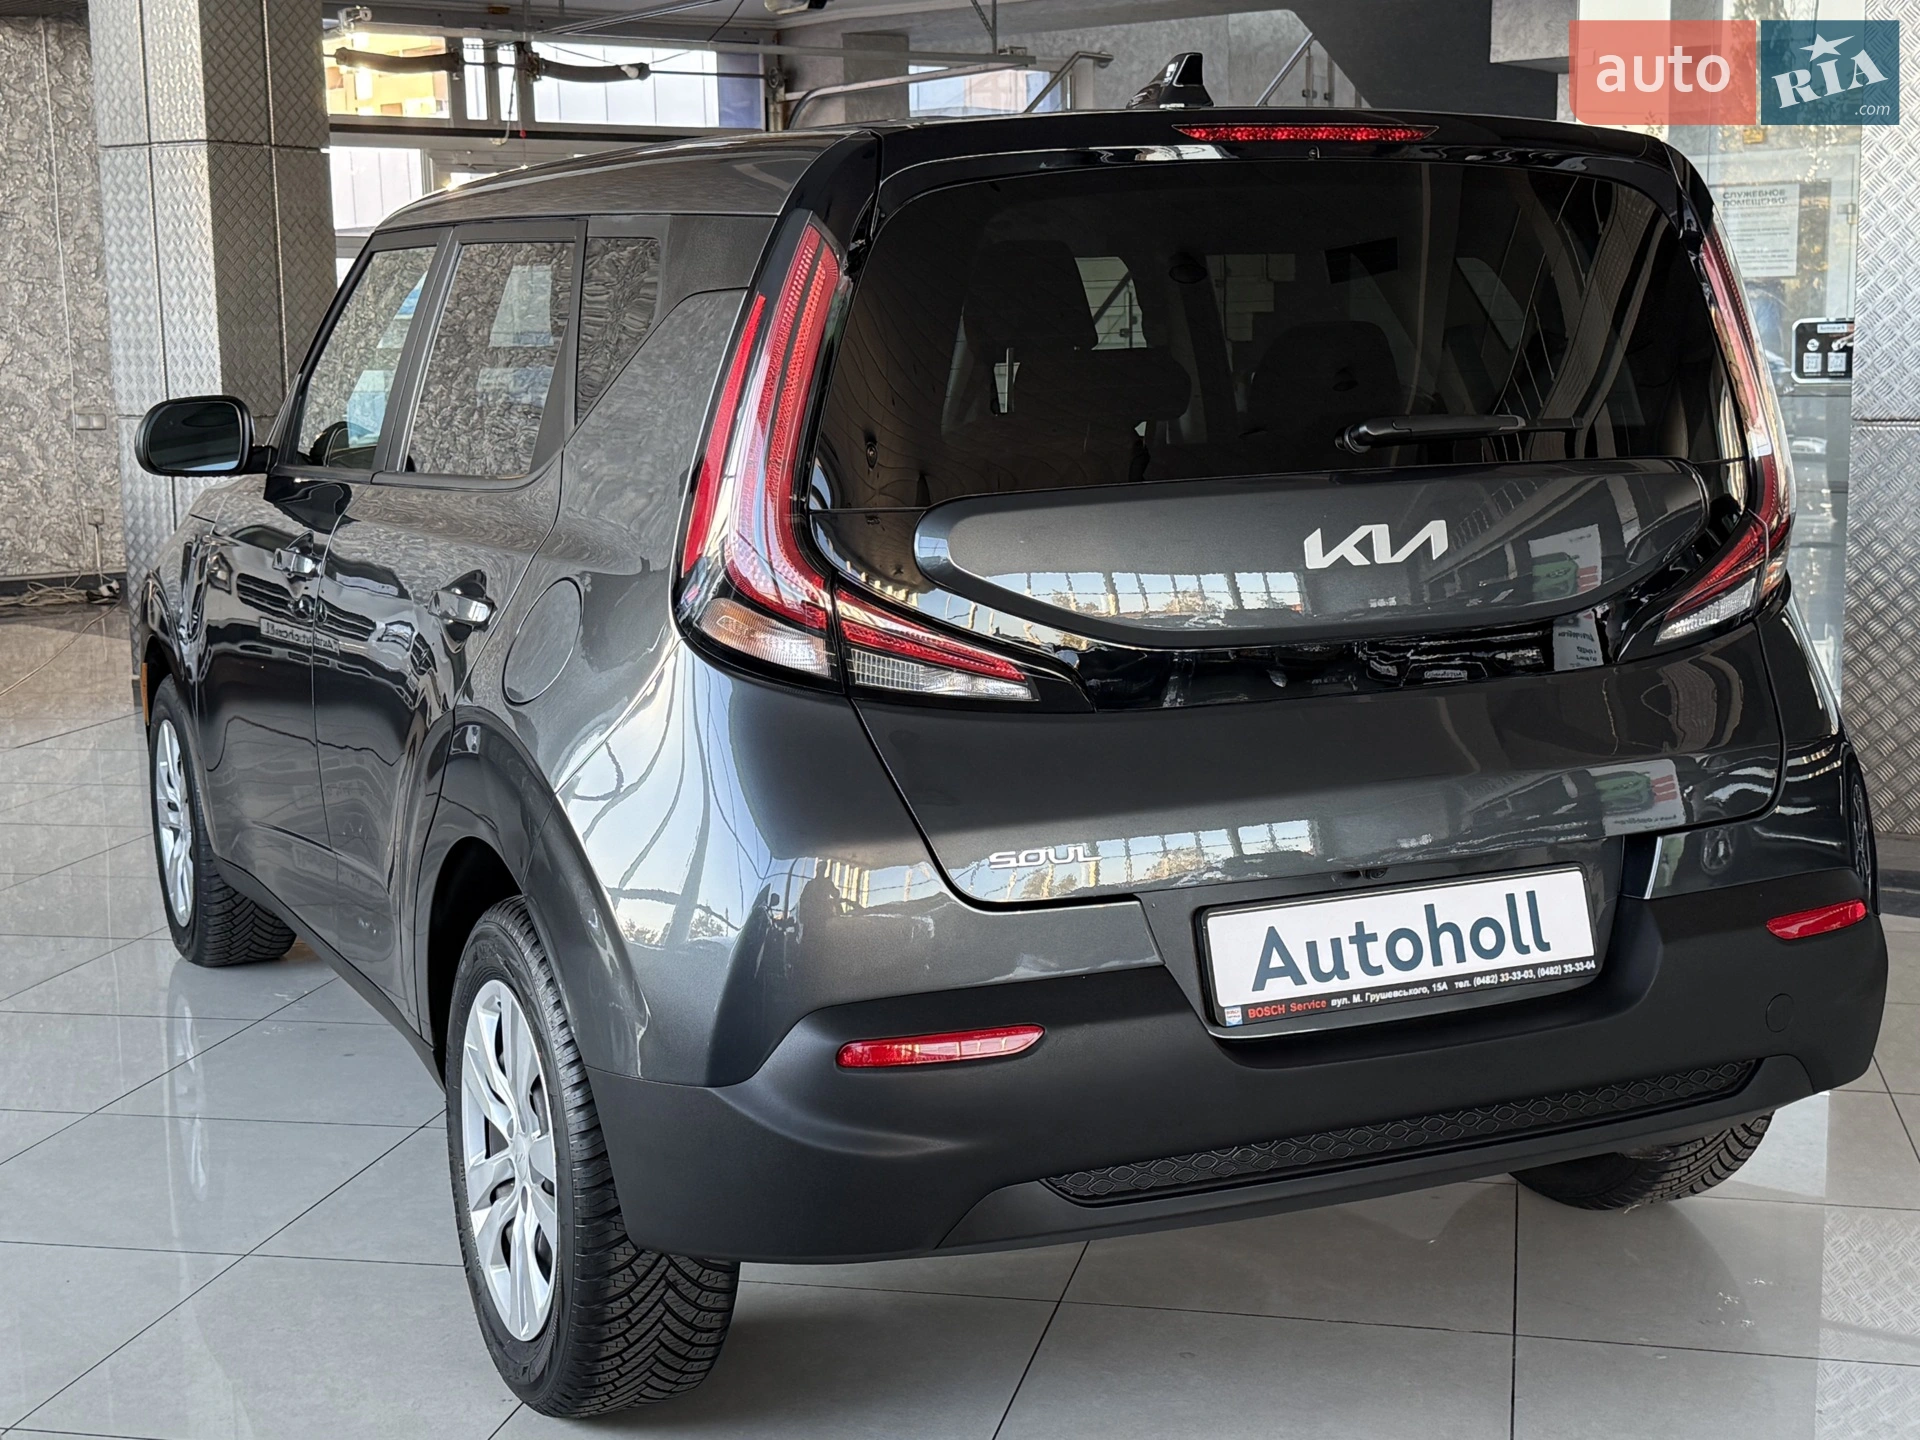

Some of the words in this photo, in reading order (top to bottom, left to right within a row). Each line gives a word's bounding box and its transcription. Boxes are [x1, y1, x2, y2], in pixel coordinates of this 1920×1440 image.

[1722, 188, 1786, 200] СЛУЖЕБНОЕ
[989, 845, 1102, 870] SOUL
[1251, 889, 1551, 992] Autoholl
[1248, 1003, 1286, 1019] BOSCH
[1290, 1000, 1327, 1013] Service
[1331, 996, 1350, 1009] вул.
[1454, 979, 1471, 989] тел.
[1473, 973, 1498, 987] (0482)
[1499, 970, 1536, 984] 33-33-03,
[1537, 964, 1562, 978] (0482)
[1563, 960, 1596, 974] 33-33-04
